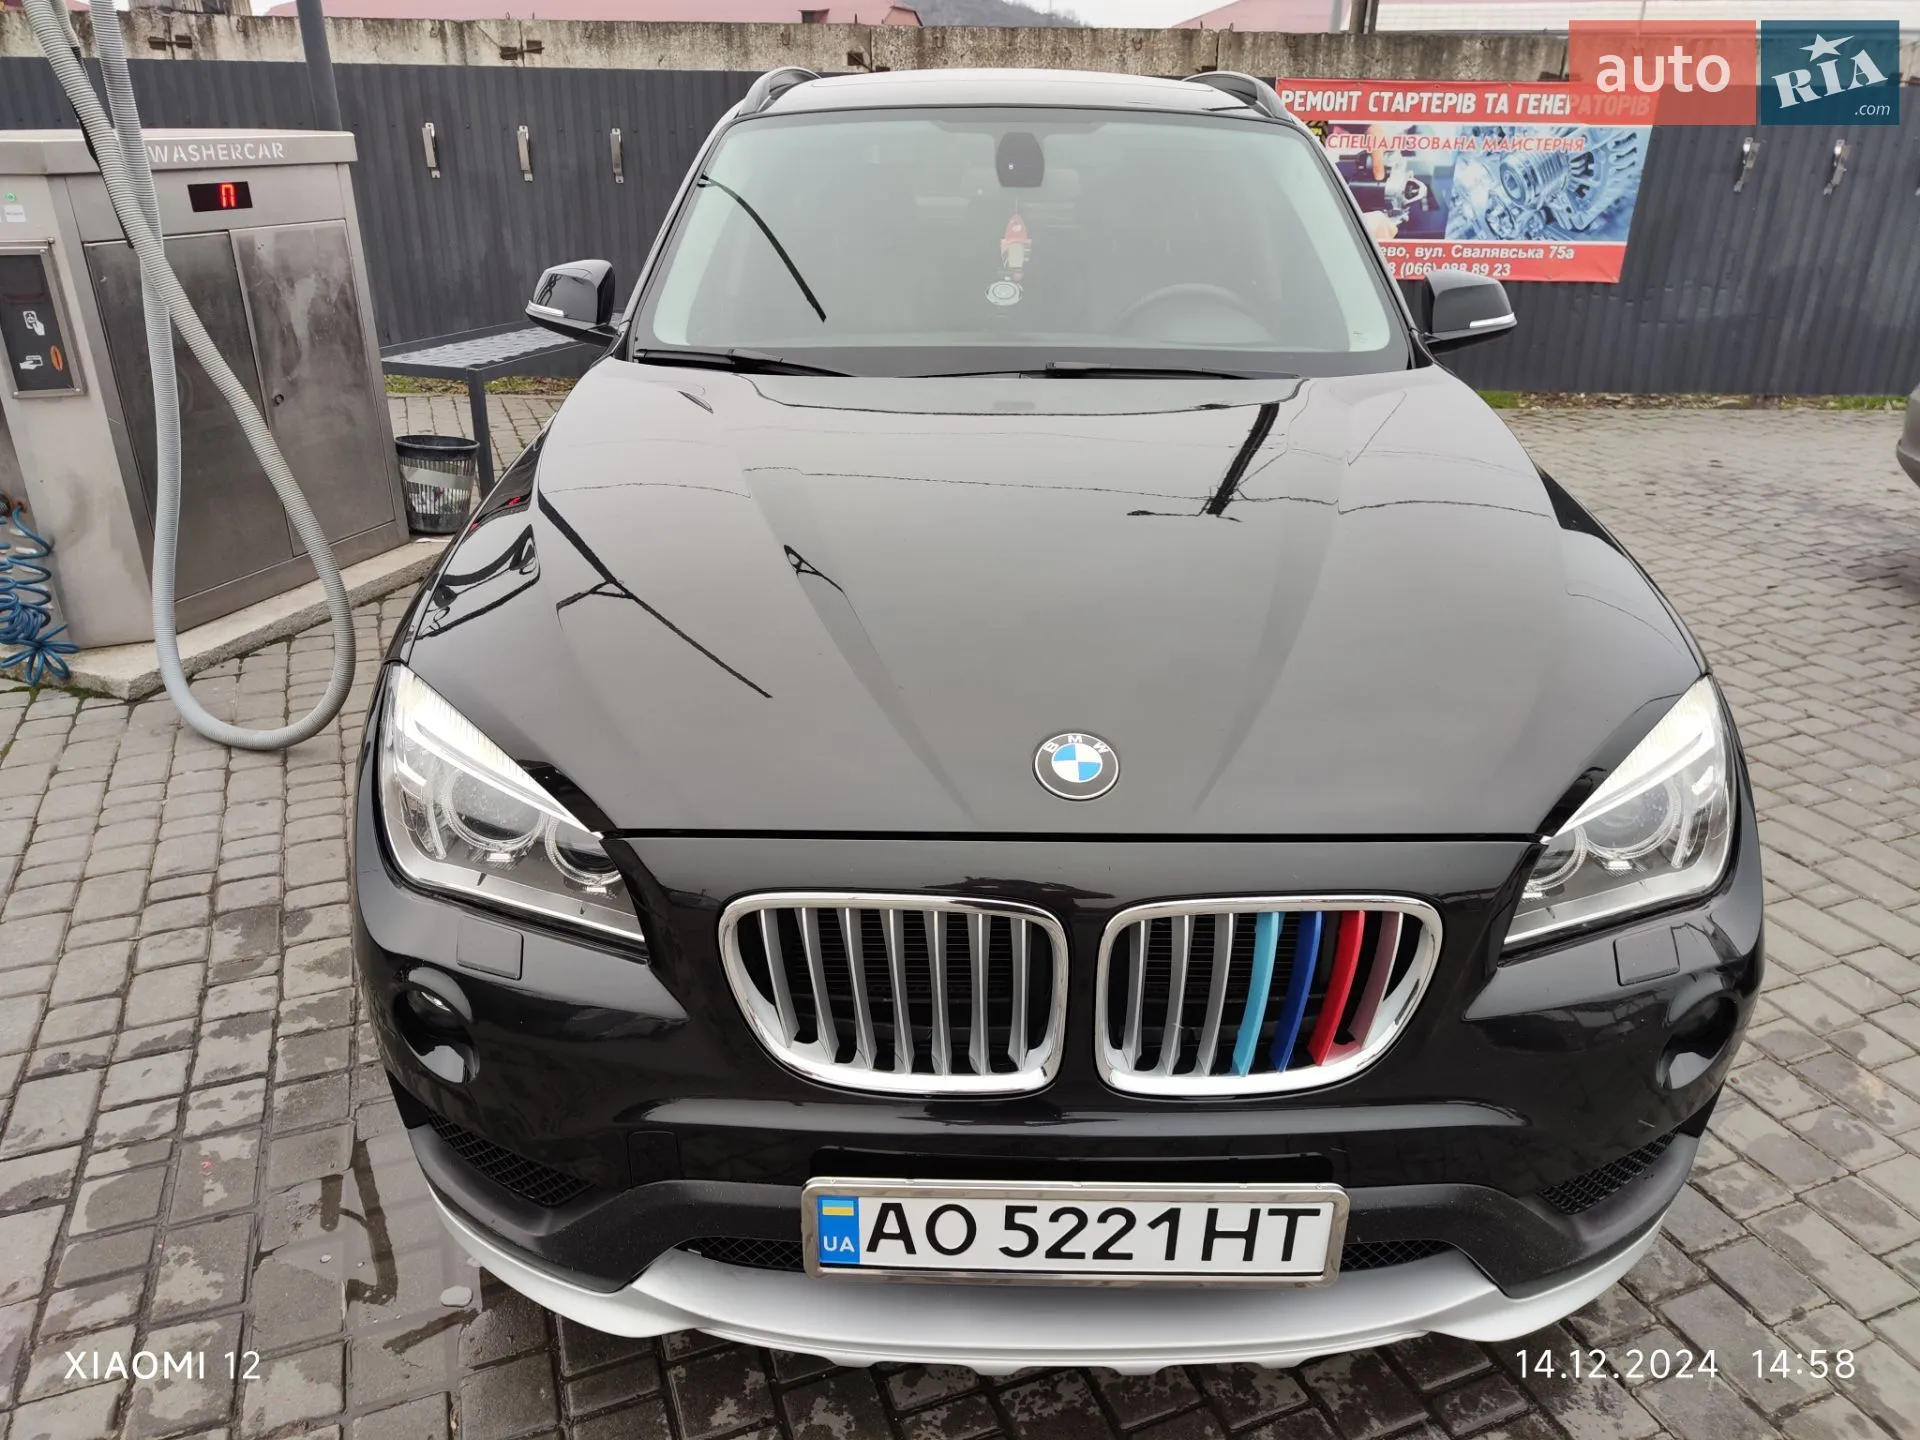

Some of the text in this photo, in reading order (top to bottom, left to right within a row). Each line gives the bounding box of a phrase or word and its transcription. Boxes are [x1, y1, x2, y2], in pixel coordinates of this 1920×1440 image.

[1281, 89, 1362, 113] РЕМОНТ
[1368, 91, 1476, 114] СТАРТЕРІВ
[1484, 92, 1509, 114] ТА
[147, 142, 285, 163] WASHERCAR
[1326, 134, 1585, 152] СПЕЦІАЛІЗОВАНА МАЙСТЕРНЯ
[1414, 246, 1446, 260] вул.
[1451, 244, 1544, 259] Свалявська
[1548, 245, 1575, 259] 75а
[1471, 263, 1489, 276] 89
[1493, 263, 1511, 277] 23
[1043, 735, 1109, 754] BMW
[998, 1204, 1182, 1262] 5221
[822, 1235, 855, 1254] UA
